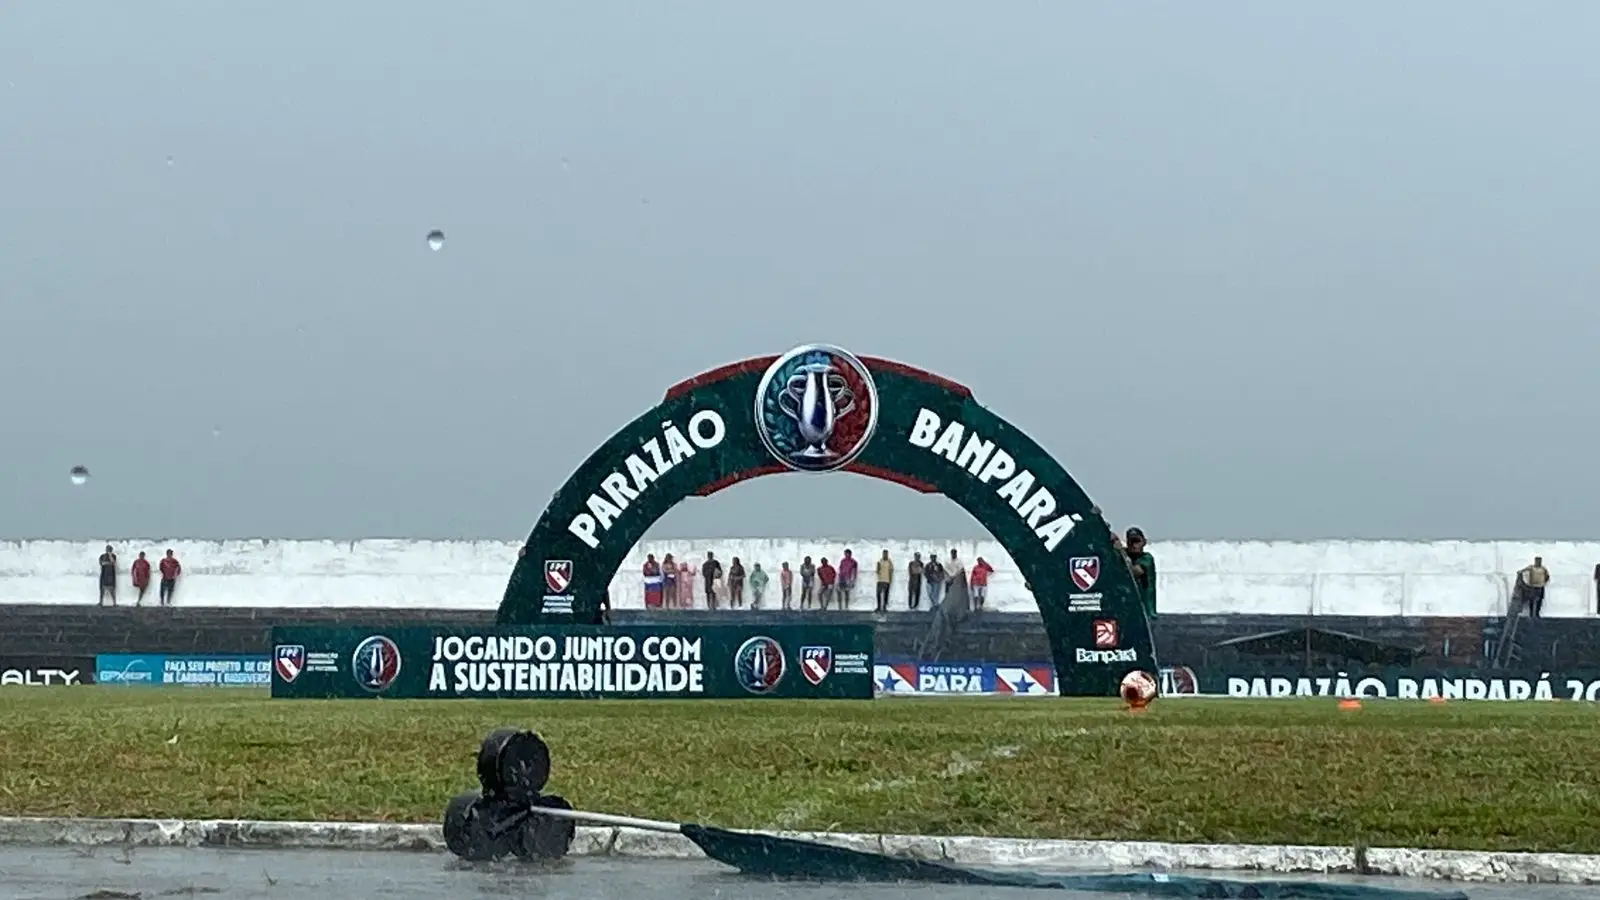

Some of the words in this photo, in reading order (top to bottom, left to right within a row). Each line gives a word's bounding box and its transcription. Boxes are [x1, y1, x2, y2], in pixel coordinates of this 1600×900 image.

[568, 409, 726, 548] PARAZÃO
[908, 407, 1084, 552] BANPARÁ
[432, 636, 556, 661] JOGANDO
[562, 636, 636, 661] JUNTO
[642, 636, 701, 661] COM
[1076, 647, 1137, 664] Banpará
[429, 663, 447, 691] A
[454, 663, 704, 692] SUSTENTABILIDADE
[1228, 672, 1387, 697] PARAZÃO
[1398, 672, 1553, 700] BANPARÁ
